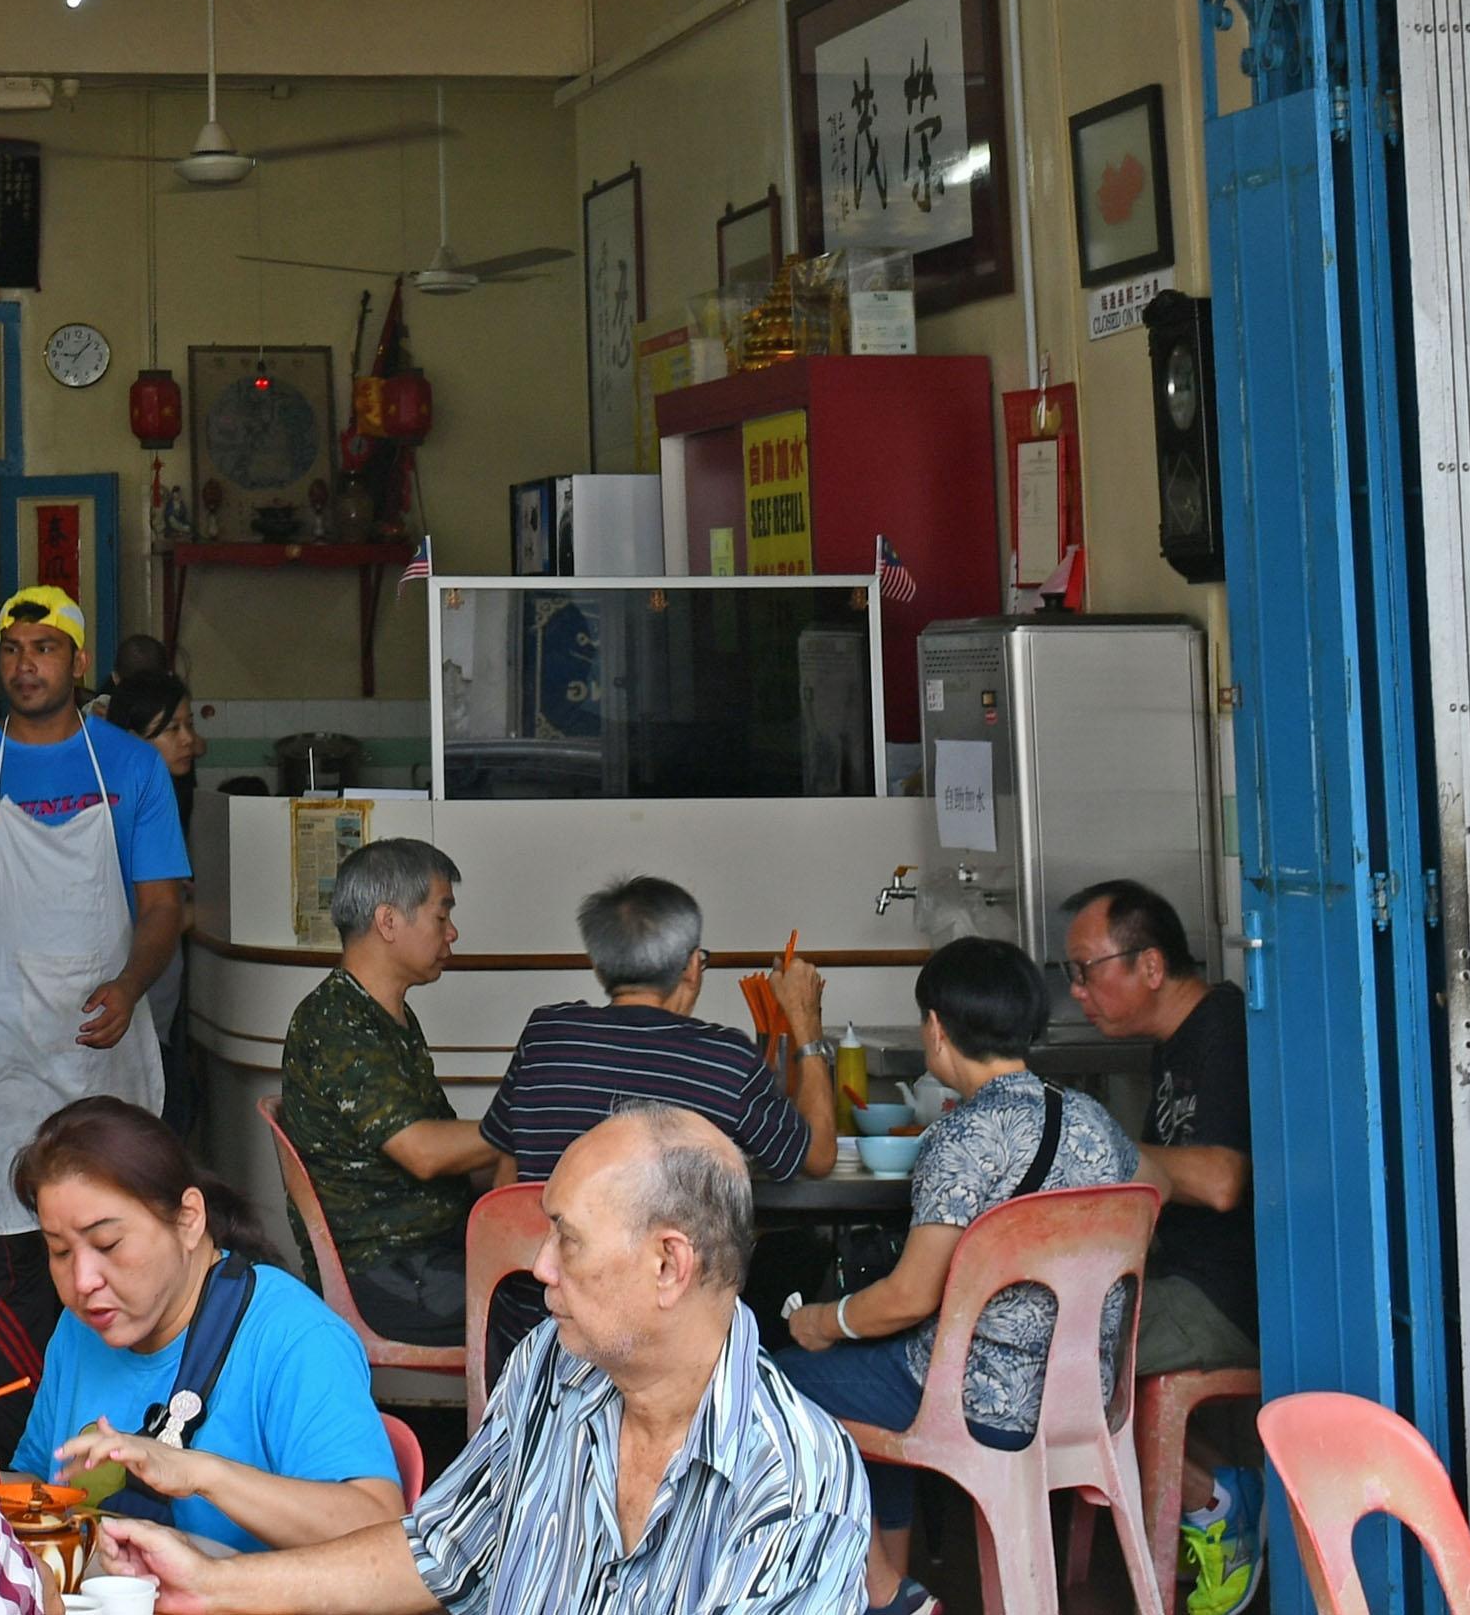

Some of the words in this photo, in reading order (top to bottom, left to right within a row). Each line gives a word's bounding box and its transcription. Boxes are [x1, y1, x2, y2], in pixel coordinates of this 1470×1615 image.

[1093, 311, 1120, 335] CLOSED
[1122, 307, 1134, 326] ON
[750, 496, 772, 539] SELF
[773, 491, 806, 536] REFILL
